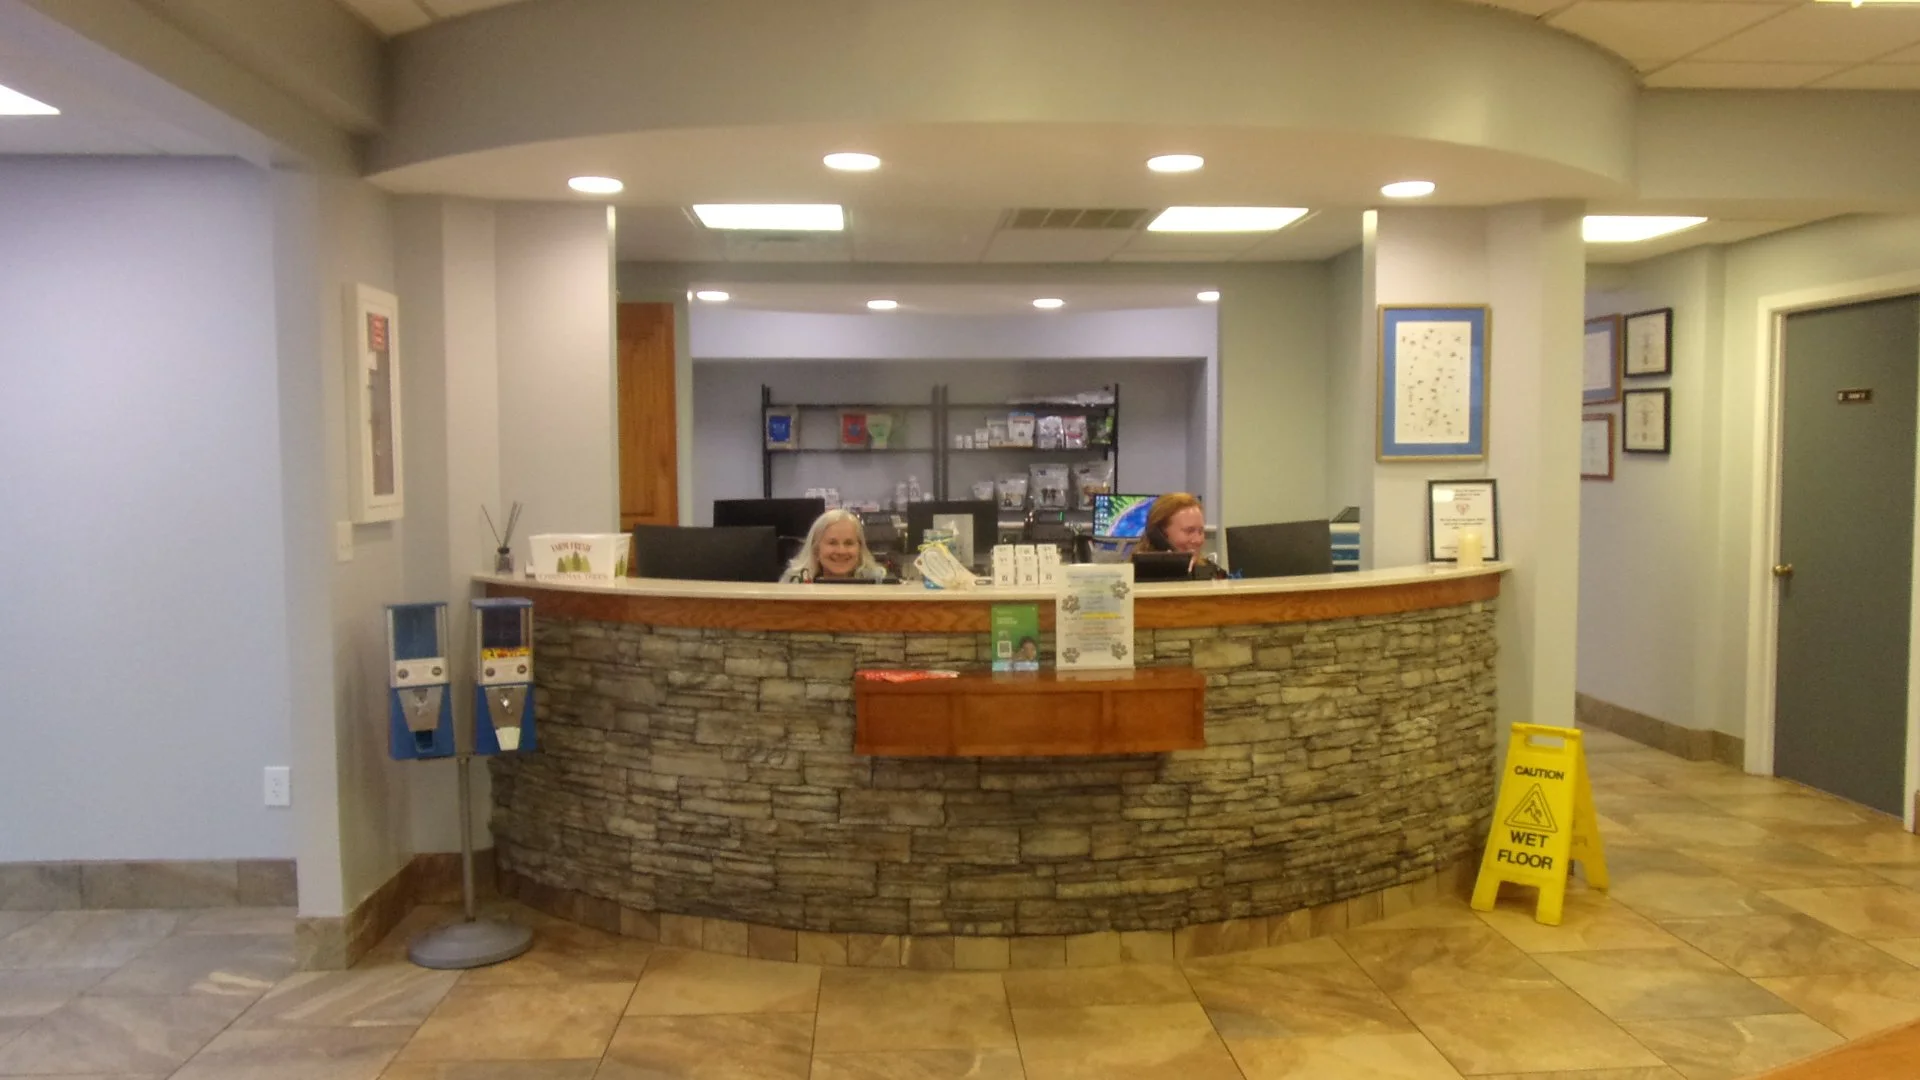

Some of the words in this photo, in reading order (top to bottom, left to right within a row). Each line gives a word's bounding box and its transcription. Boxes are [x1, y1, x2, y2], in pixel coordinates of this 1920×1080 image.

[550, 542, 569, 553] FARM
[571, 541, 592, 553] FRESH
[1514, 765, 1565, 780] CAUTION
[1510, 830, 1549, 848] WET
[1497, 849, 1553, 870] FLOOR
